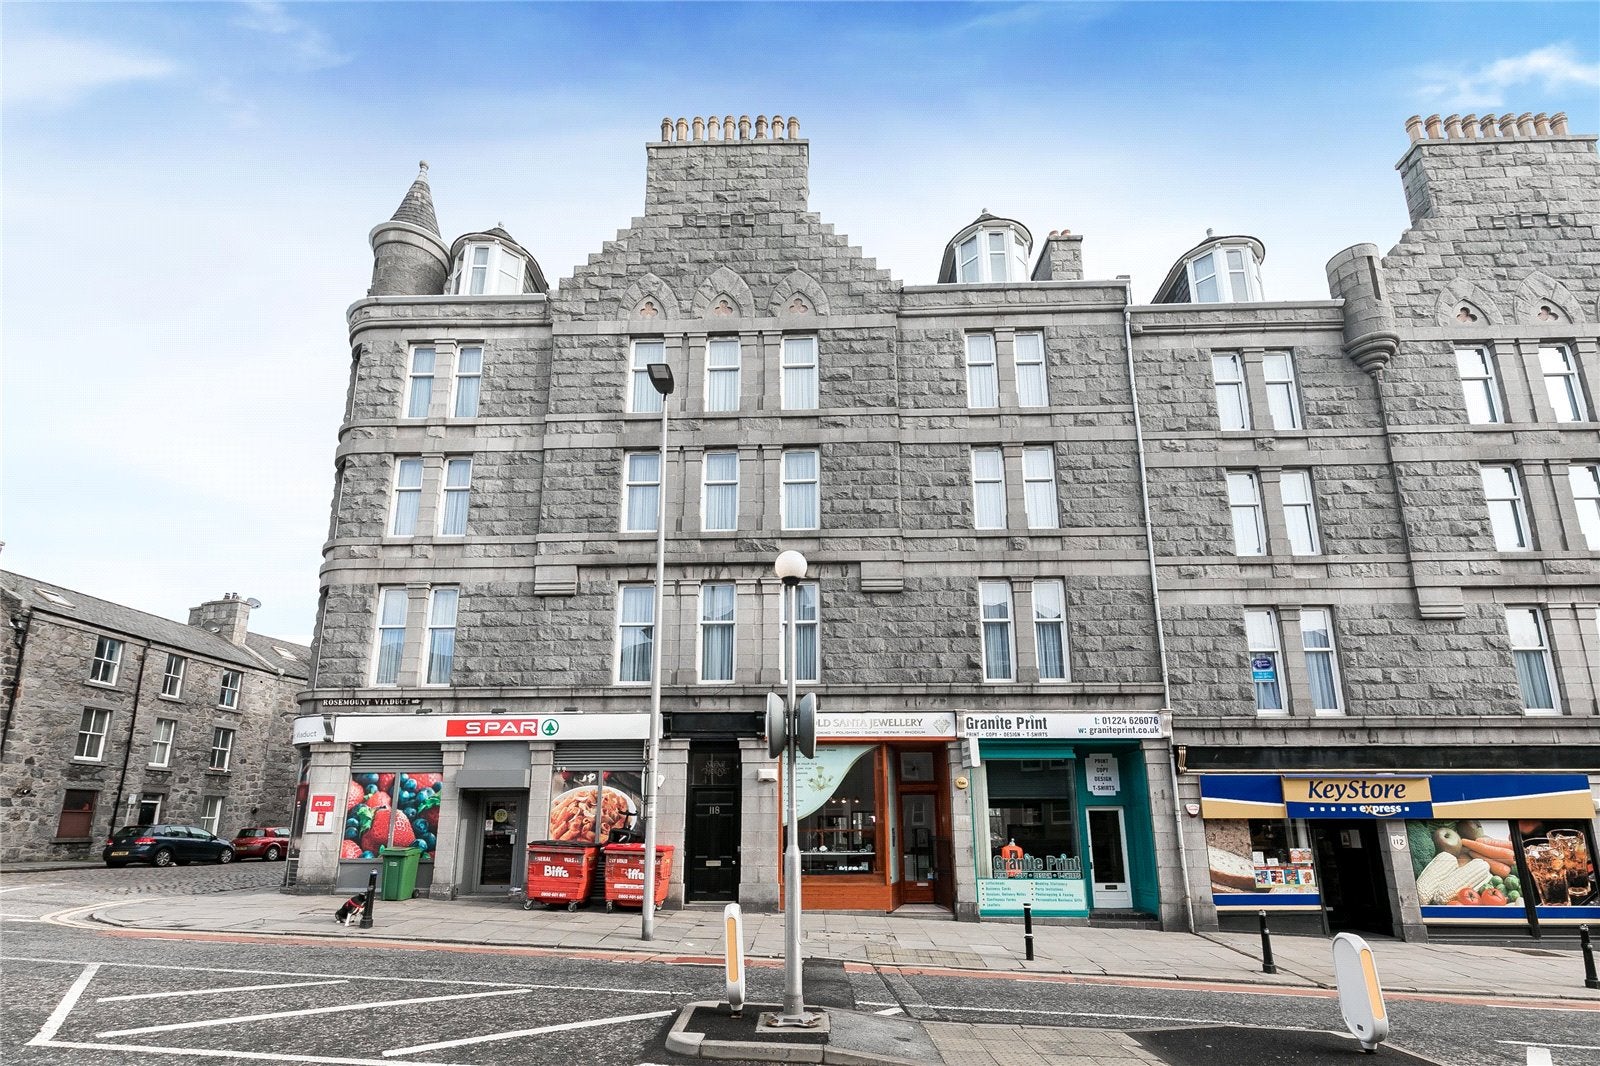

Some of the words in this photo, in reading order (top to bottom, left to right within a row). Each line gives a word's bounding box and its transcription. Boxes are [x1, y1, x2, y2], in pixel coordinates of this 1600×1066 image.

[322, 698, 371, 706] ROSEMOUNT
[374, 698, 410, 706] VIADUCT
[833, 719, 868, 728] SANTA
[869, 718, 923, 729] JEWELLERY
[966, 715, 1012, 730] Granite
[1016, 715, 1048, 730] Print
[1102, 716, 1127, 725] 01224
[1128, 716, 1159, 725] 626076
[465, 721, 537, 735] SPAR
[1089, 725, 1160, 736] graniteprint.co.uk
[1308, 780, 1406, 802] KeyStore
[709, 806, 720, 815] 118
[1359, 804, 1402, 814] express
[993, 853, 1043, 871] Granite
[1046, 853, 1081, 871] Print
[544, 865, 569, 878] Biffa
